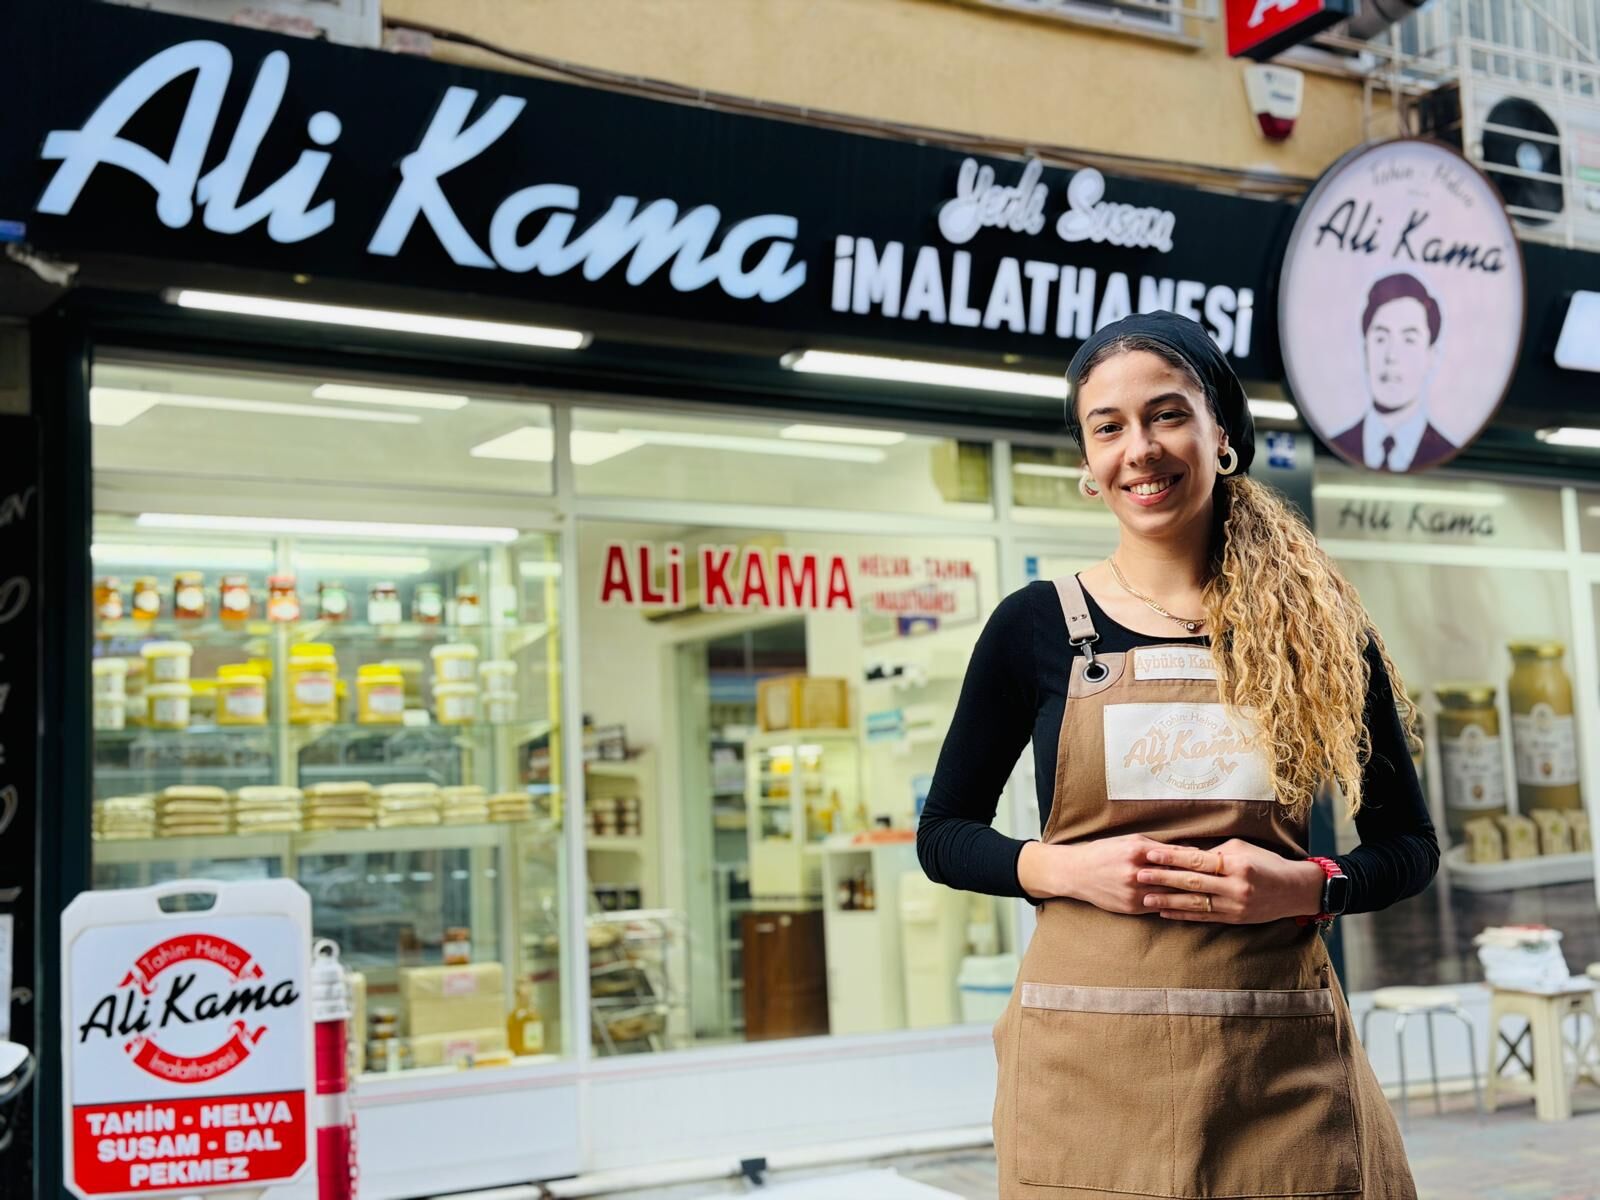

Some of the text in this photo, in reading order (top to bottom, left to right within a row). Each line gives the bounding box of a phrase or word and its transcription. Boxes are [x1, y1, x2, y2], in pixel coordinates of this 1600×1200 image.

[36, 39, 806, 303] Ali Kama
[938, 158, 1049, 244] Yerli
[1316, 200, 1506, 273] Ali Kama
[1406, 502, 1495, 537] Kama
[704, 550, 854, 609] KAMA
[1136, 653, 1186, 673] Aybüke
[1123, 735, 1168, 769] Ali
[195, 939, 241, 970] Helva
[79, 973, 300, 1043] Ali Kama
[86, 1104, 176, 1136] TAHİN
[200, 1101, 293, 1129] HELVA
[97, 1133, 201, 1163] SUSAM
[225, 1128, 282, 1154] BAL
[129, 1156, 250, 1187] PEKMEZ
